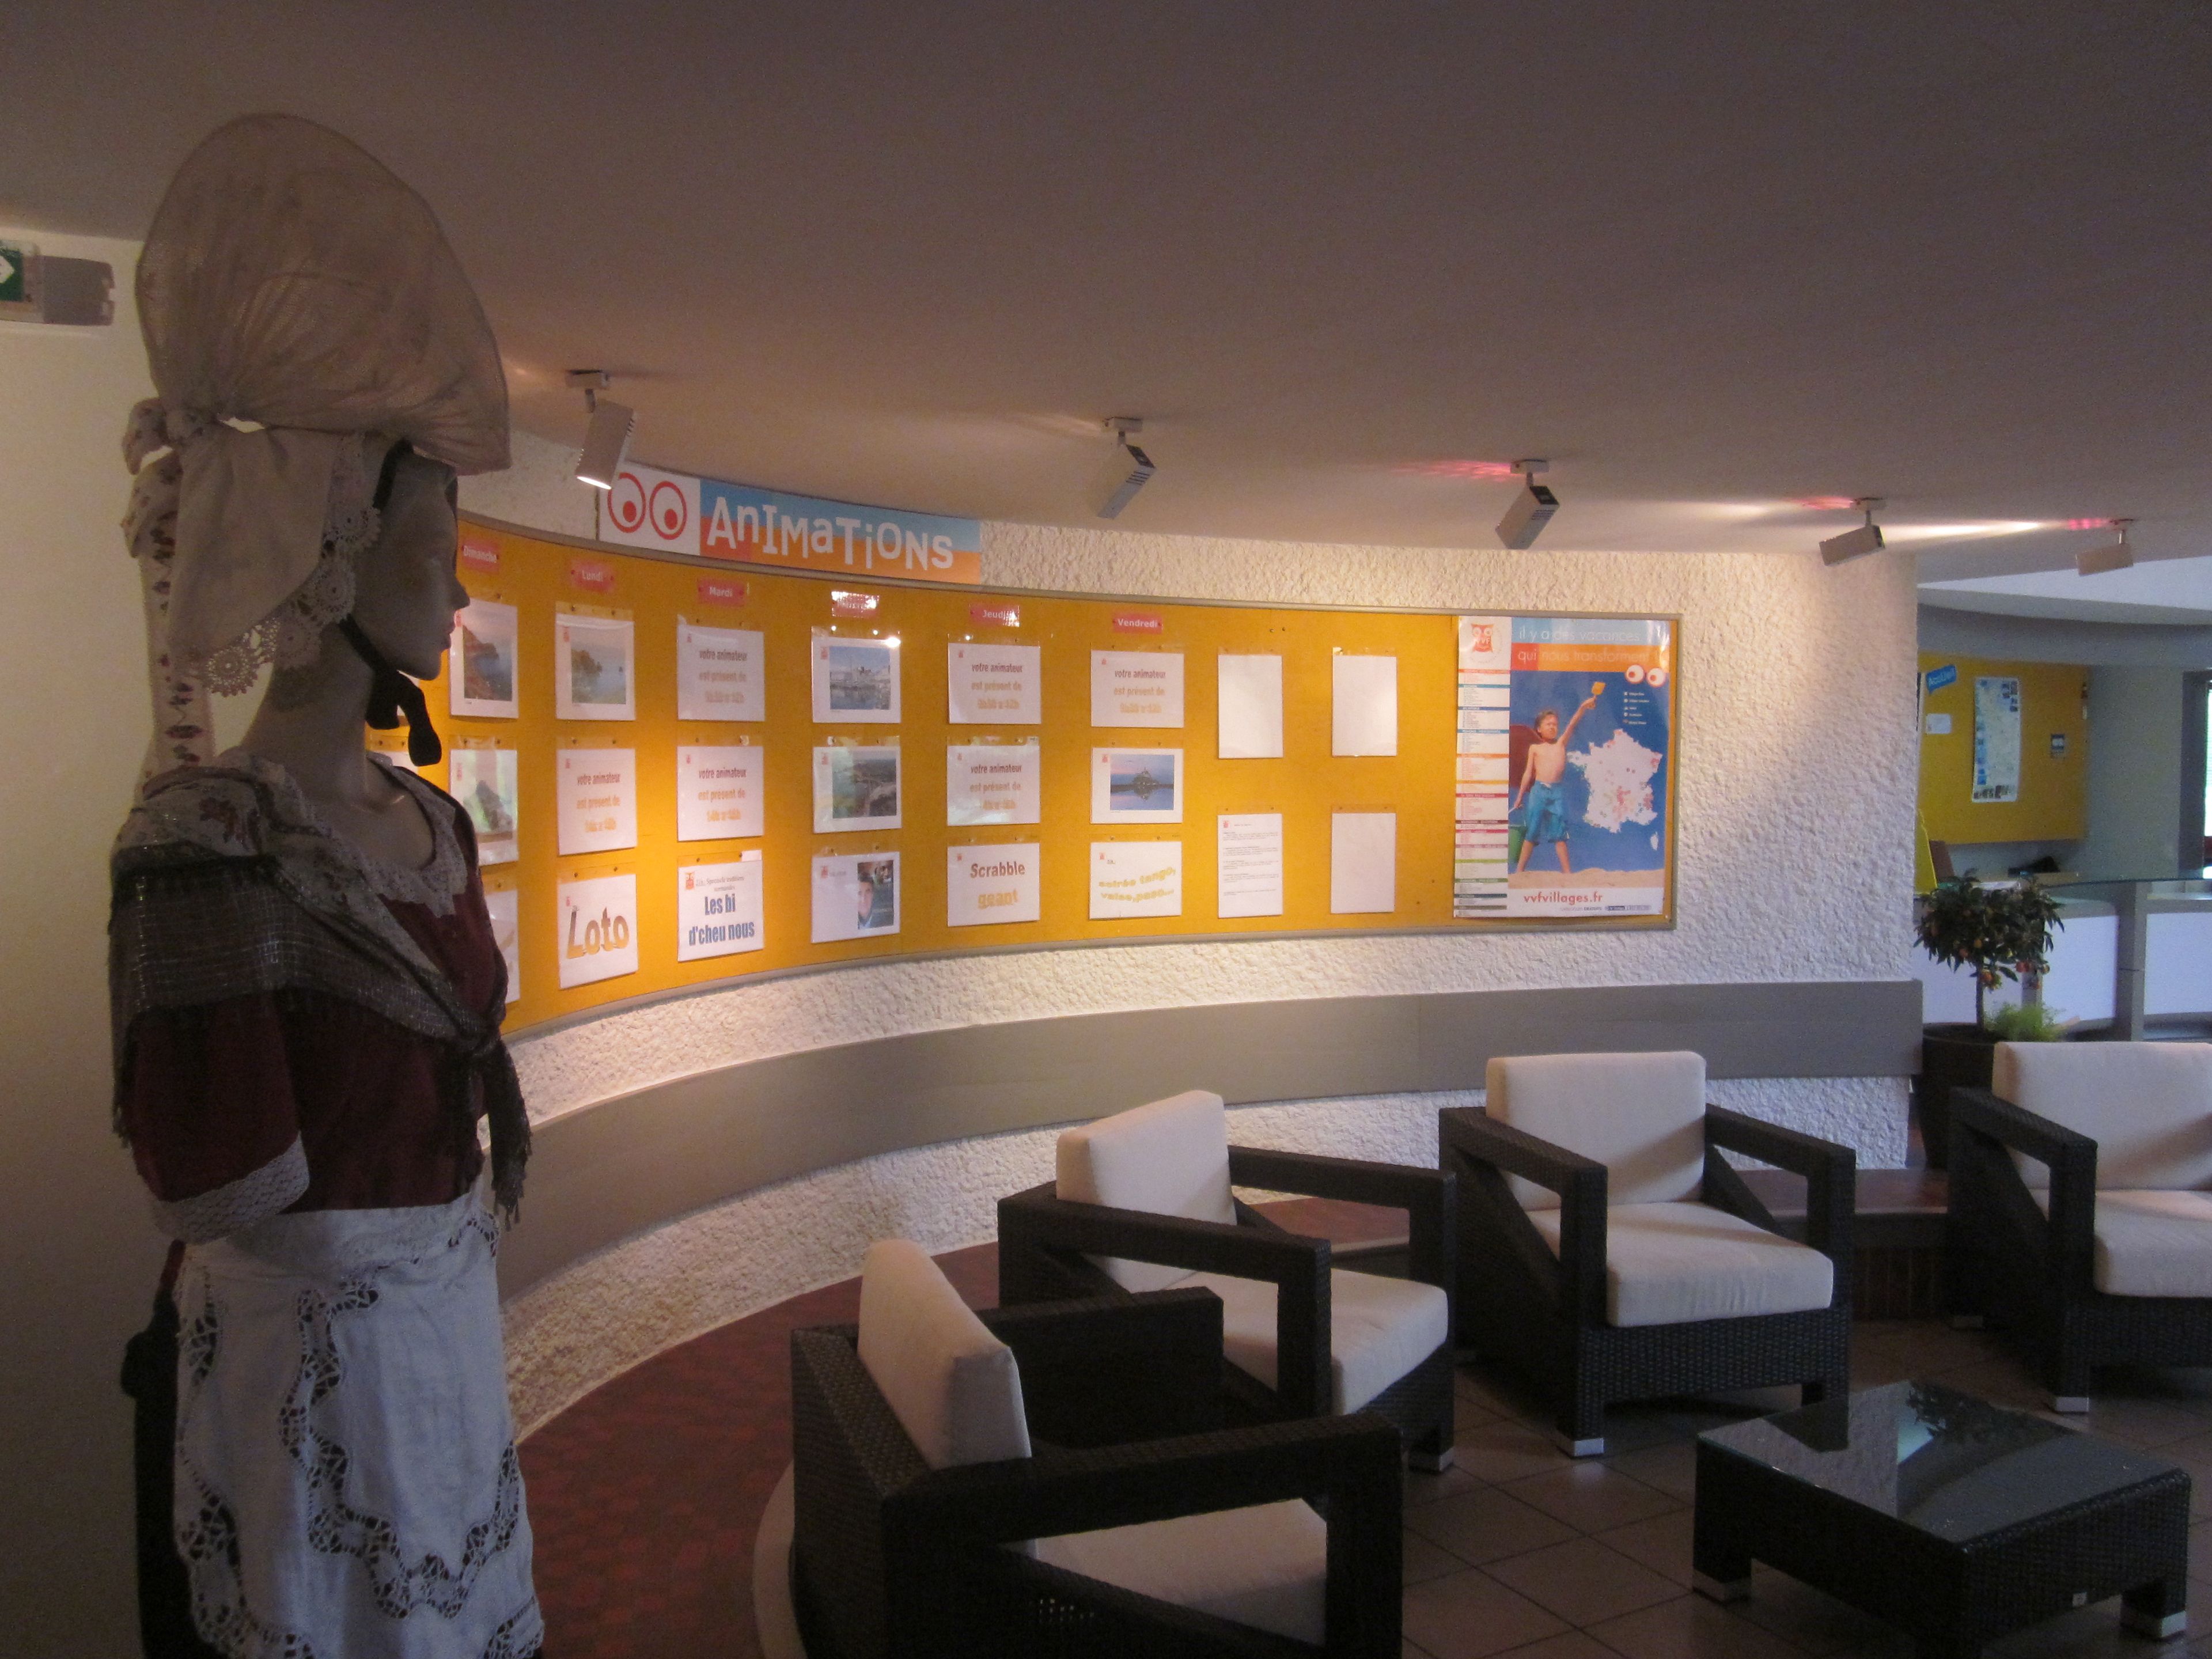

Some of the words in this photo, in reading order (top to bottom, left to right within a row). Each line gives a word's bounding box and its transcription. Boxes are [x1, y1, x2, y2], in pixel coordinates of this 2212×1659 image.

[582, 570, 604, 582] Lundi
[709, 586, 733, 597] Mardi
[1118, 618, 1158, 628] Vendredi
[1529, 630, 1536, 643] y
[1541, 630, 1550, 640] a
[1580, 632, 1640, 642] vacances
[699, 650, 715, 660] votre
[717, 649, 748, 662] animateur
[1518, 649, 1537, 664] qui
[1542, 651, 1570, 662] nous
[1574, 647, 1649, 662] transforment
[972, 662, 988, 672] votre
[990, 663, 1022, 673] animateur
[1115, 669, 1131, 678] votre
[1133, 669, 1165, 679] animateur
[699, 768, 714, 779] votre
[716, 767, 747, 778] animateur
[971, 764, 987, 774] votre
[989, 763, 1022, 774] animateur
[970, 861, 1025, 878] Scrabble
[704, 896, 723, 916] Les
[725, 893, 736, 913] bi
[1524, 891, 1603, 906] vvfvillages.fr
[567, 907, 630, 959] Loto
[689, 925, 726, 946] d'cheu
[728, 922, 755, 941] nous
